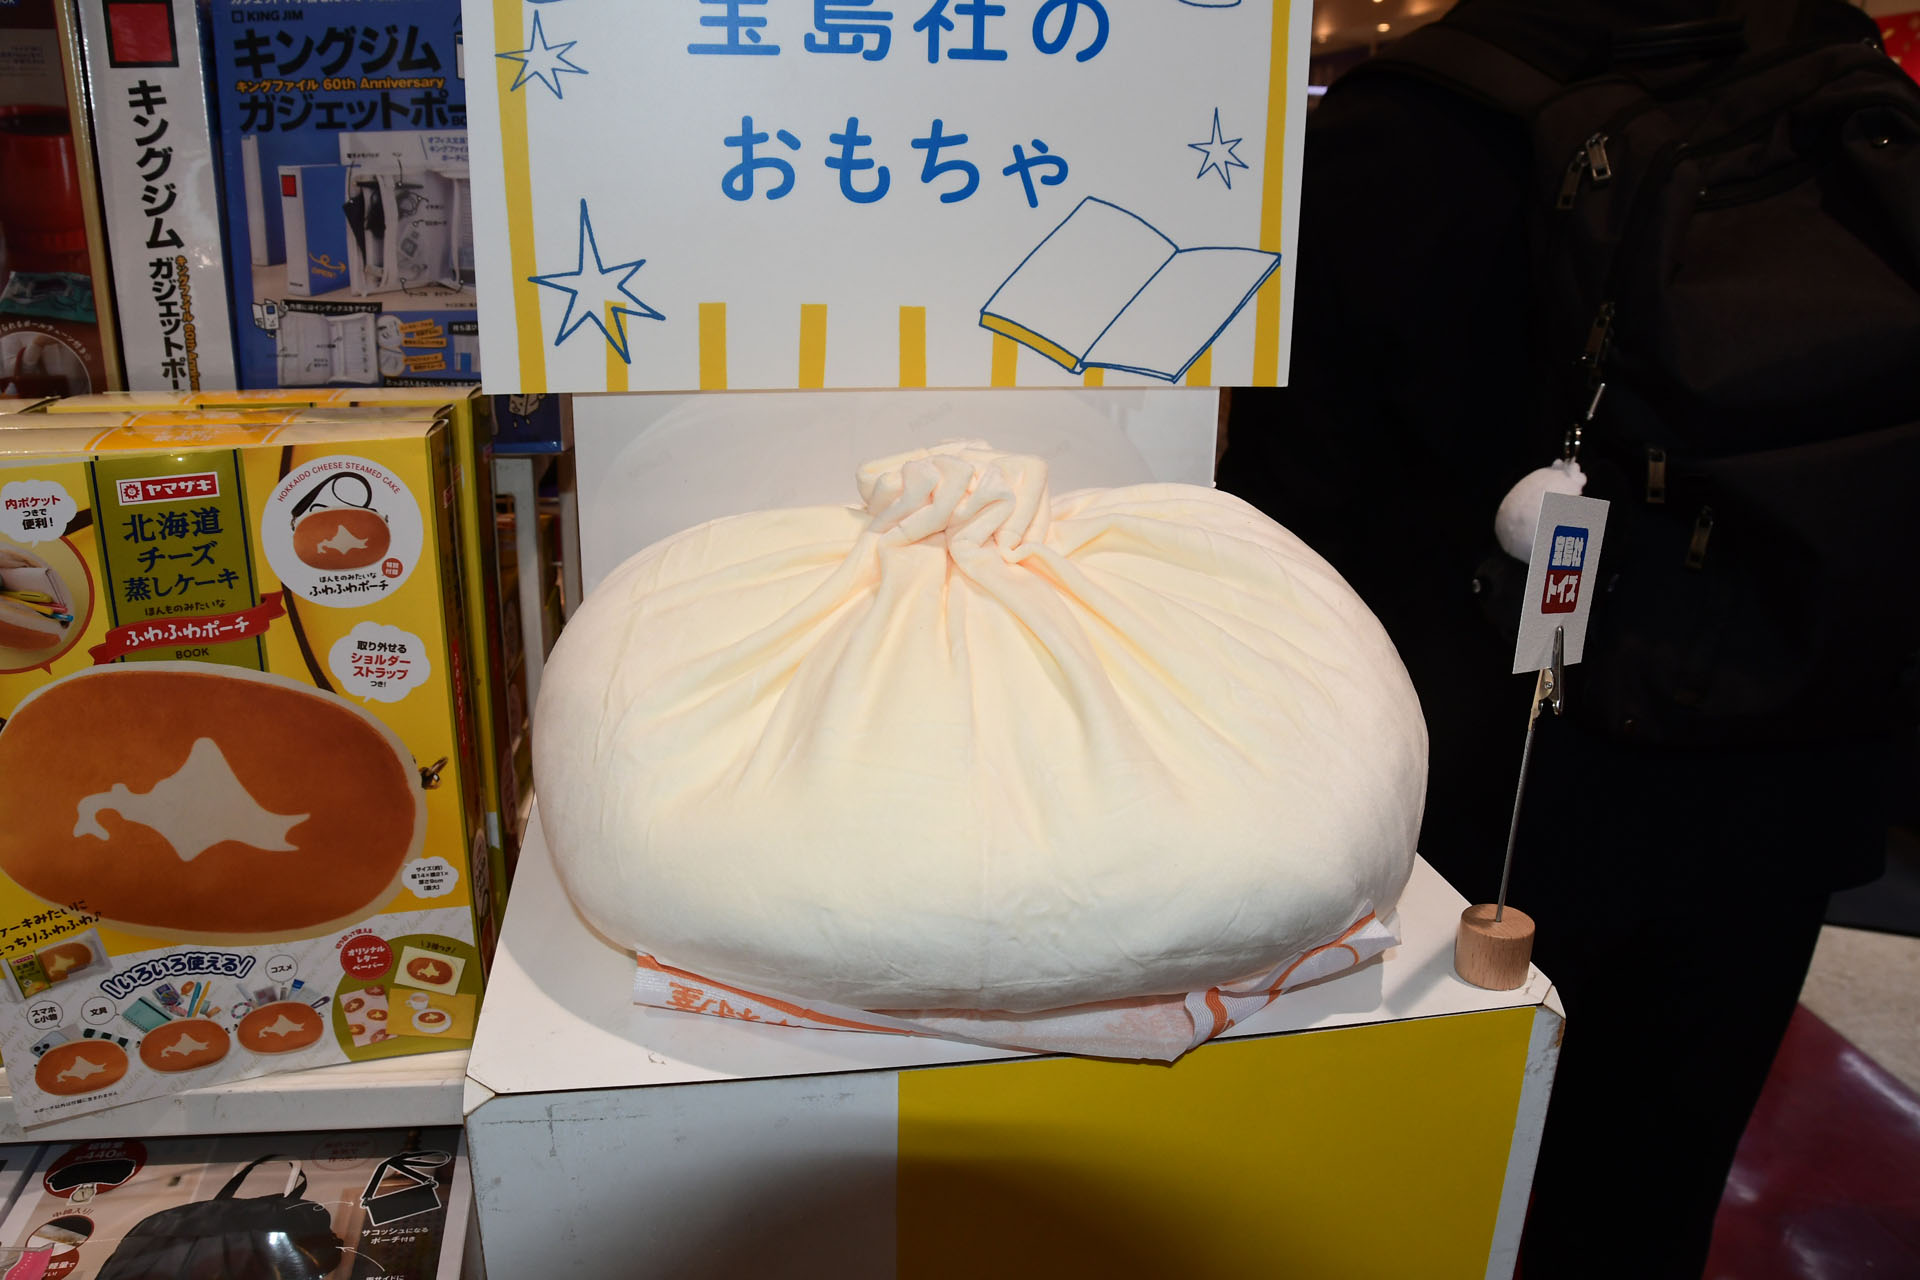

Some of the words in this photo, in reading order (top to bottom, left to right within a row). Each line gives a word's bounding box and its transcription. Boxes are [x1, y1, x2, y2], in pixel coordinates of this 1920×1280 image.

[247, 10, 280, 22] KING
[282, 10, 304, 22] JIM
[234, 25, 441, 78] キングジム
[236, 78, 319, 94] キングファイル
[322, 78, 356, 92] 60th
[360, 75, 446, 90] Anniversary
[128, 80, 184, 250] キングジム
[721, 115, 1069, 209] おもちゃ
[146, 479, 212, 497] ヤマザキ
[277, 471, 311, 503] HOKKAIDO
[312, 461, 343, 474] CHEESE
[345, 461, 383, 479] STEAMED
[382, 477, 401, 495] CAKE
[5, 494, 61, 510] 内ポケット
[22, 508, 47, 517] つきで
[122, 506, 223, 544] 北海道
[137, 540, 218, 573] チーズ
[319, 572, 377, 583] ほんものみたいな
[123, 568, 240, 603] 蒸しケーキ
[309, 580, 389, 597] ふわふわポーチ
[144, 599, 226, 617] ほんものみたいな
[126, 616, 250, 646] ふわふわポーチ
[357, 640, 407, 653] 取り外せる
[175, 648, 209, 660] BOOK
[351, 652, 411, 666] ショルダー
[353, 666, 408, 680] ストラップ
[348, 945, 385, 957] オリジナル
[357, 955, 379, 963] レター
[271, 963, 293, 974] コスメ
[31, 1006, 56, 1018] スマホ
[90, 1007, 107, 1016] 文具
[362, 1227, 429, 1237] サコッシュになる
[370, 1236, 416, 1245] ポーチ付き
